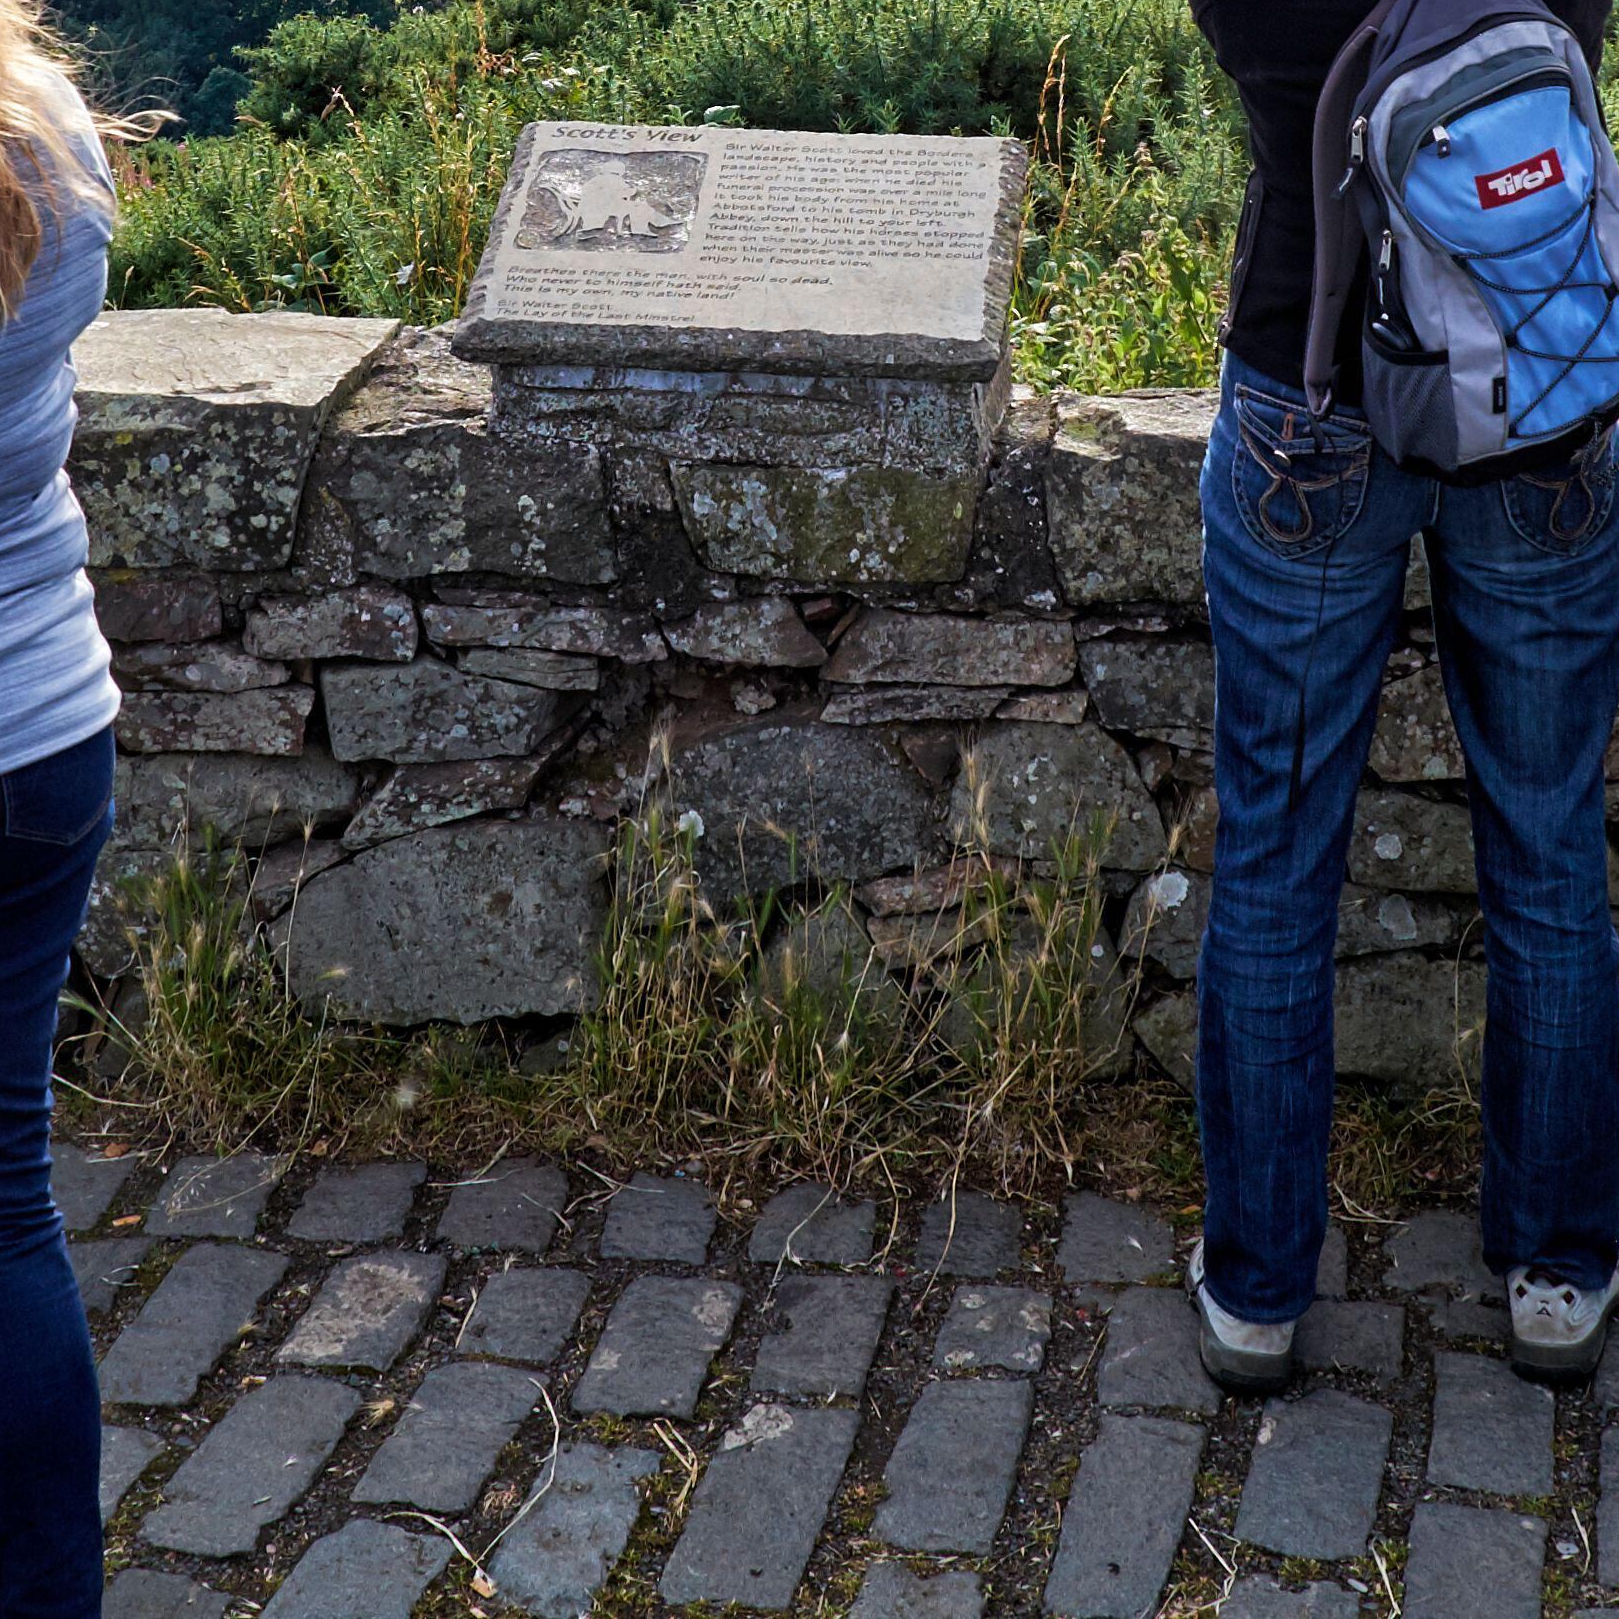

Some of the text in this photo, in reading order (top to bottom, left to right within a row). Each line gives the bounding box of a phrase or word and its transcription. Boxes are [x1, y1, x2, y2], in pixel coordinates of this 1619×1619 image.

[552, 126, 703, 142] Scott's View
[725, 143, 974, 158] Sir Walter Scott loved the Borders
[805, 155, 856, 166] history
[892, 159, 939, 168] people
[718, 173, 761, 181] writer
[905, 178, 937, 186] died
[941, 179, 963, 187] his
[914, 169, 971, 178] popular
[1488, 159, 1553, 197] Tirol
[716, 182, 764, 191] funeral
[768, 185, 845, 194] procession
[926, 189, 953, 197] mile
[730, 193, 763, 201] took
[794, 195, 829, 204] body
[833, 196, 868, 204] from
[872, 197, 895, 205] his
[899, 198, 939, 206] home
[712, 202, 795, 213] Abbotsford
[821, 206, 843, 214] his
[849, 207, 886, 215] tomb
[909, 208, 976, 219] Dryburgh
[709, 213, 756, 223] Abbey,
[760, 214, 799, 222] down
[804, 216, 829, 224] the
[708, 222, 985, 240] Tradition tells how his horses stopped
[705, 233, 735, 241] here
[762, 235, 786, 243] the
[822, 238, 854, 247] just
[881, 239, 913, 248] they
[917, 240, 944, 248] had
[948, 241, 984, 249] done
[702, 244, 737, 252] when
[742, 245, 776, 253] their
[925, 251, 942, 259] he
[945, 252, 983, 260] could
[700, 255, 738, 264] enjoy
[742, 255, 764, 263] his
[769, 256, 836, 266] favourite
[506, 274, 537, 283] Who
[585, 278, 602, 286] to
[606, 279, 663, 288] himself
[666, 280, 702, 289] hath
[508, 266, 577, 276] Breathes
[582, 268, 621, 277] there
[626, 270, 651, 278] the
[732, 275, 765, 283] soul
[504, 284, 533, 293] This
[539, 285, 552, 293] is
[556, 288, 579, 296] my
[620, 290, 643, 298] my
[646, 290, 693, 298] native
[696, 291, 735, 300] land!
[497, 299, 612, 311] Sir Walter Scott
[524, 309, 548, 318] Lay
[635, 313, 695, 322] Minstrel
